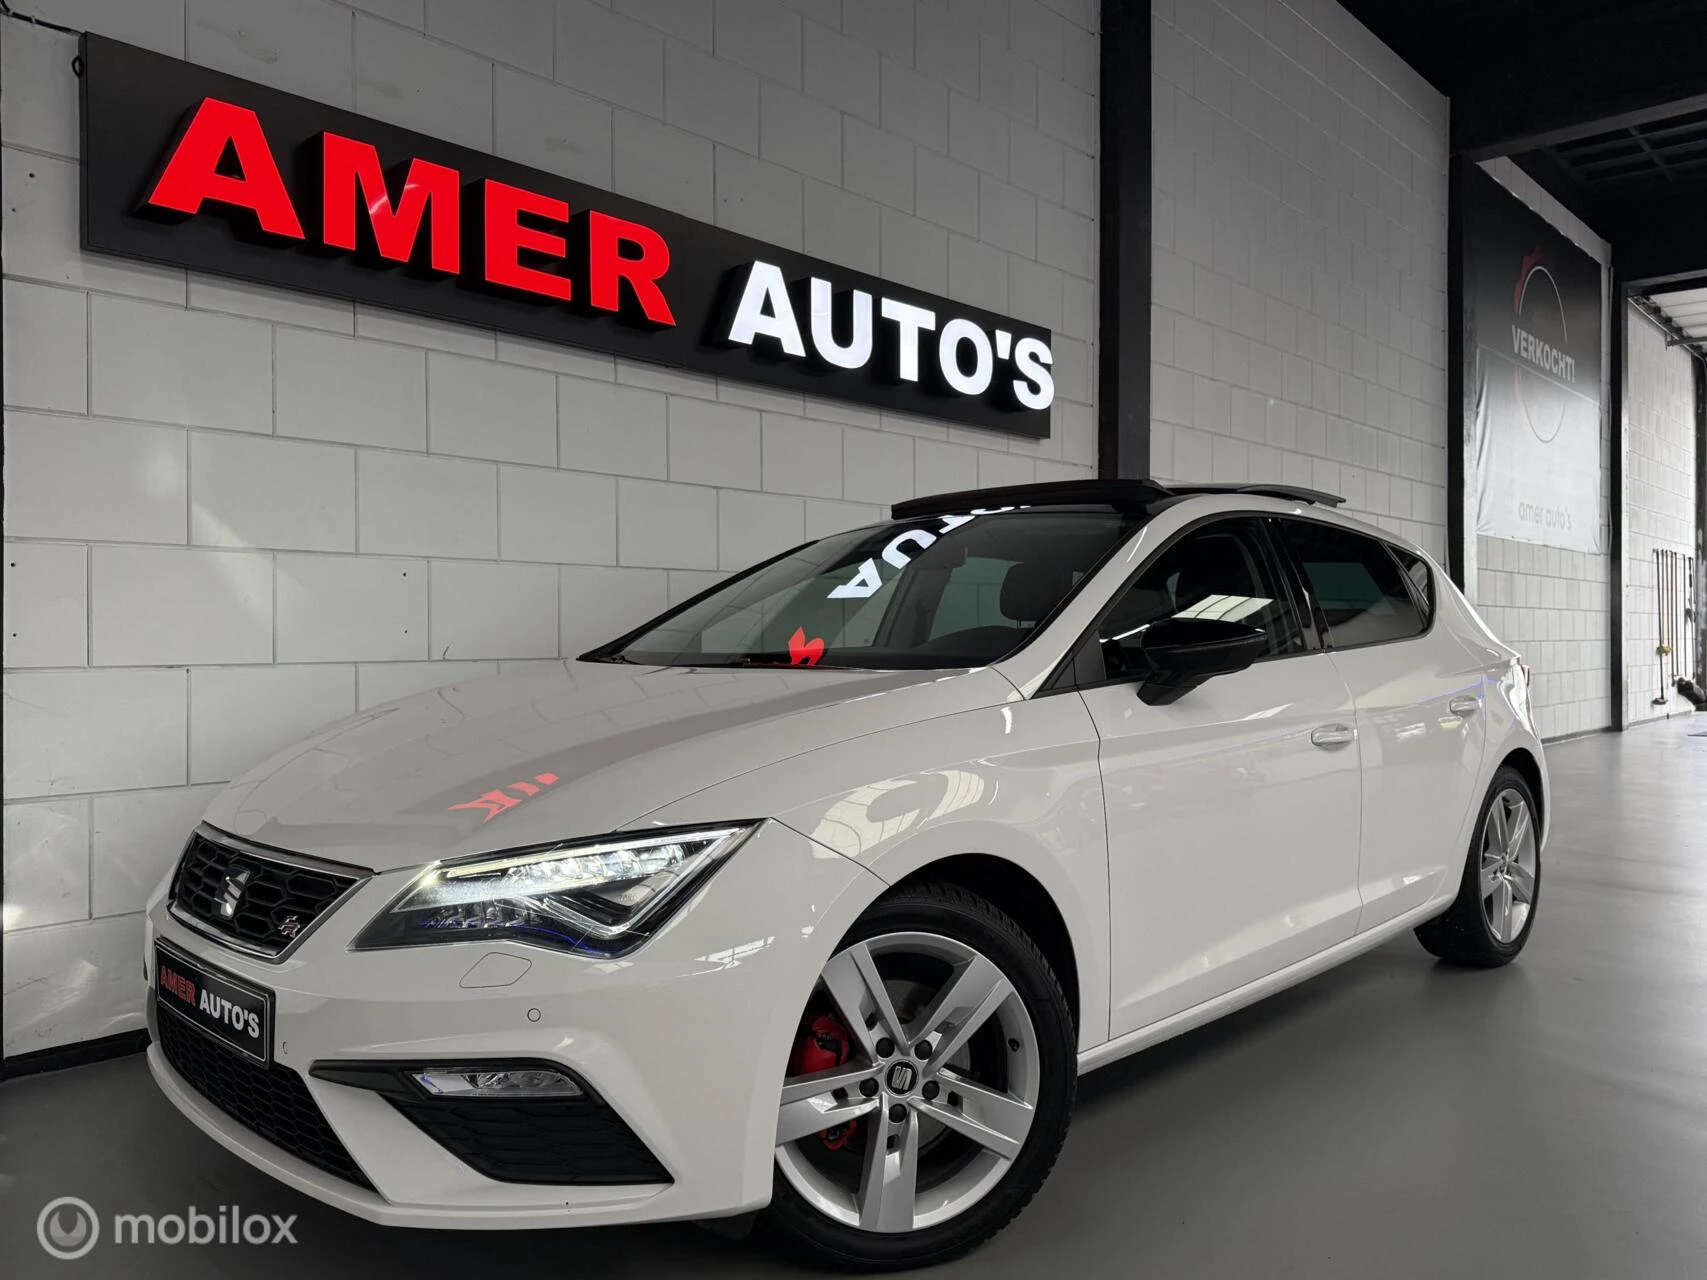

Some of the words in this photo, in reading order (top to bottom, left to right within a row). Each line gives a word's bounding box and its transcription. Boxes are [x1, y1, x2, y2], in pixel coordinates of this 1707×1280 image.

[148, 97, 677, 327] AMER
[728, 260, 1055, 410] AUTO'S
[1511, 324, 1575, 383] VERKOCHT!
[1518, 502, 1544, 525] amer
[160, 965, 196, 1007] AMER
[200, 989, 260, 1039] AUTO'S
